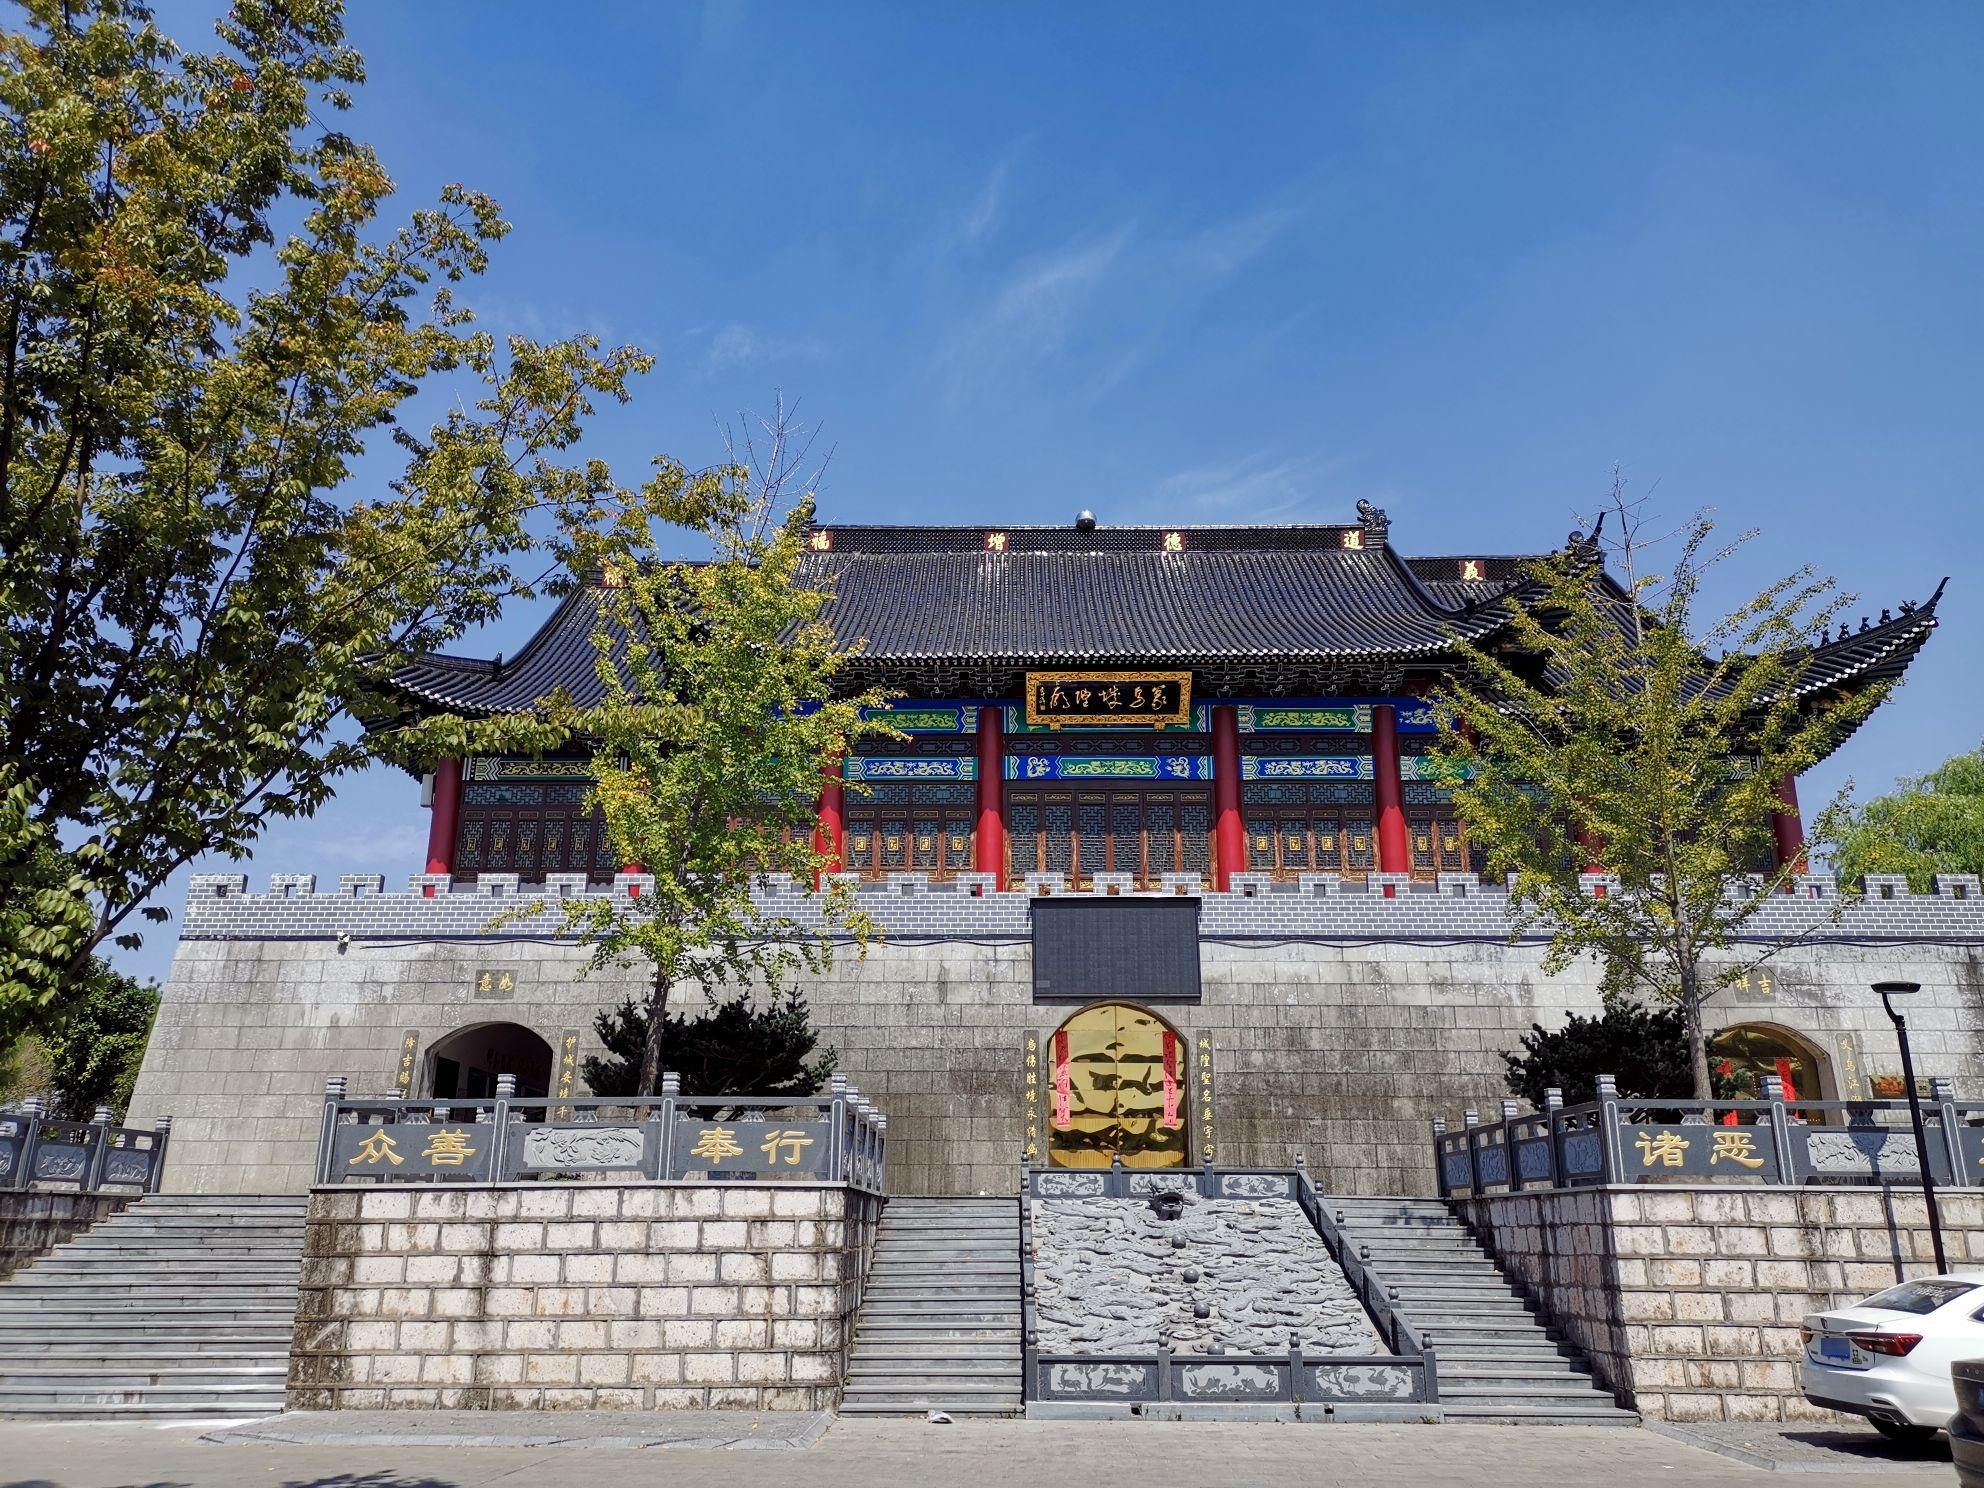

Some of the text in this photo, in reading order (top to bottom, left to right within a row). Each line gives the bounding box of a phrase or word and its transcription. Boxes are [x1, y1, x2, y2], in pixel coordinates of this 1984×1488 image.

[810, 530, 1364, 551] 道 德 增 福
[1734, 973, 1772, 994] 吉祥
[349, 1126, 814, 1166] 众善 奉行
[1635, 1129, 1766, 1169] 诸恶
